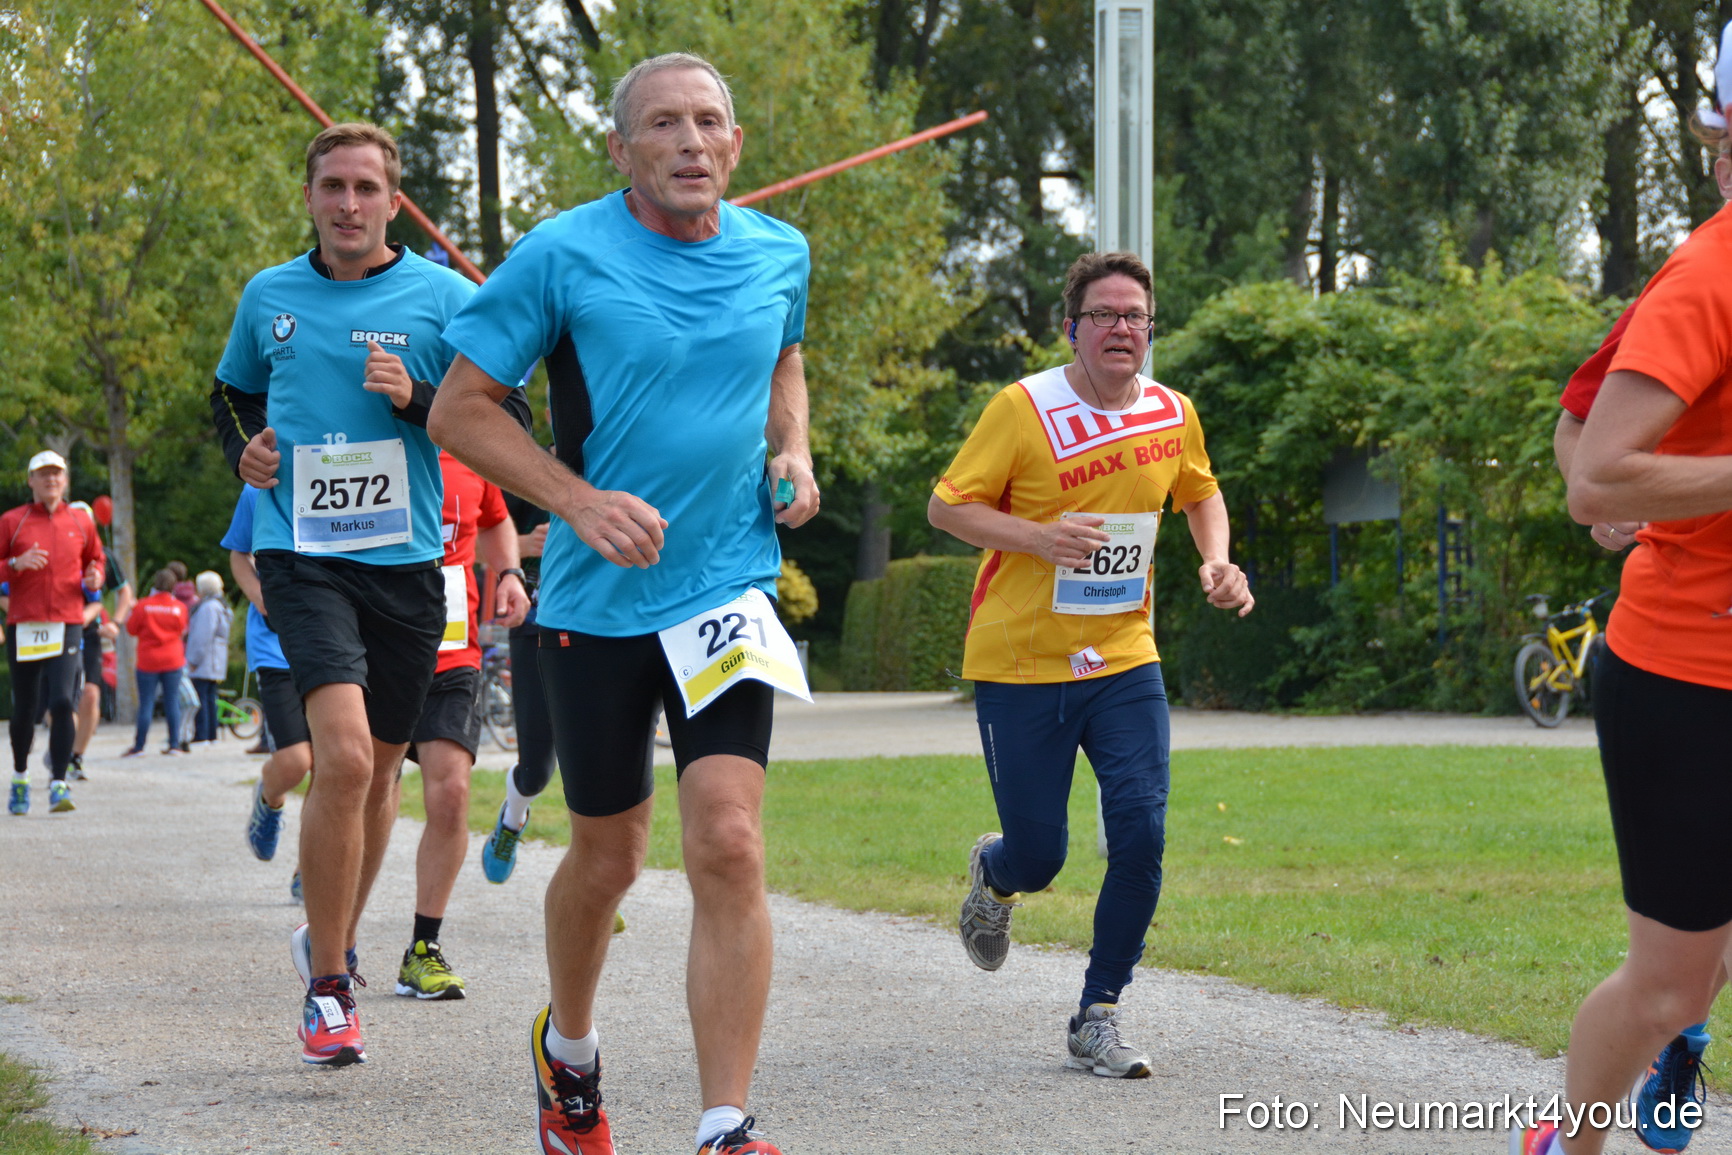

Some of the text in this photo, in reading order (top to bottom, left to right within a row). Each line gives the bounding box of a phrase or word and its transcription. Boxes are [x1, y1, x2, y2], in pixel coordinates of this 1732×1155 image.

[351, 330, 410, 347] BOCK
[332, 452, 373, 463] BOCK
[1058, 437, 1183, 491] MAX BÖGL
[310, 474, 391, 510] 2572
[331, 519, 375, 533] Markus
[1102, 523, 1135, 532] BOCK
[1083, 585, 1127, 598] Christoph
[32, 630, 49, 643] 70
[698, 612, 768, 659] 221
[721, 650, 770, 674] Günther
